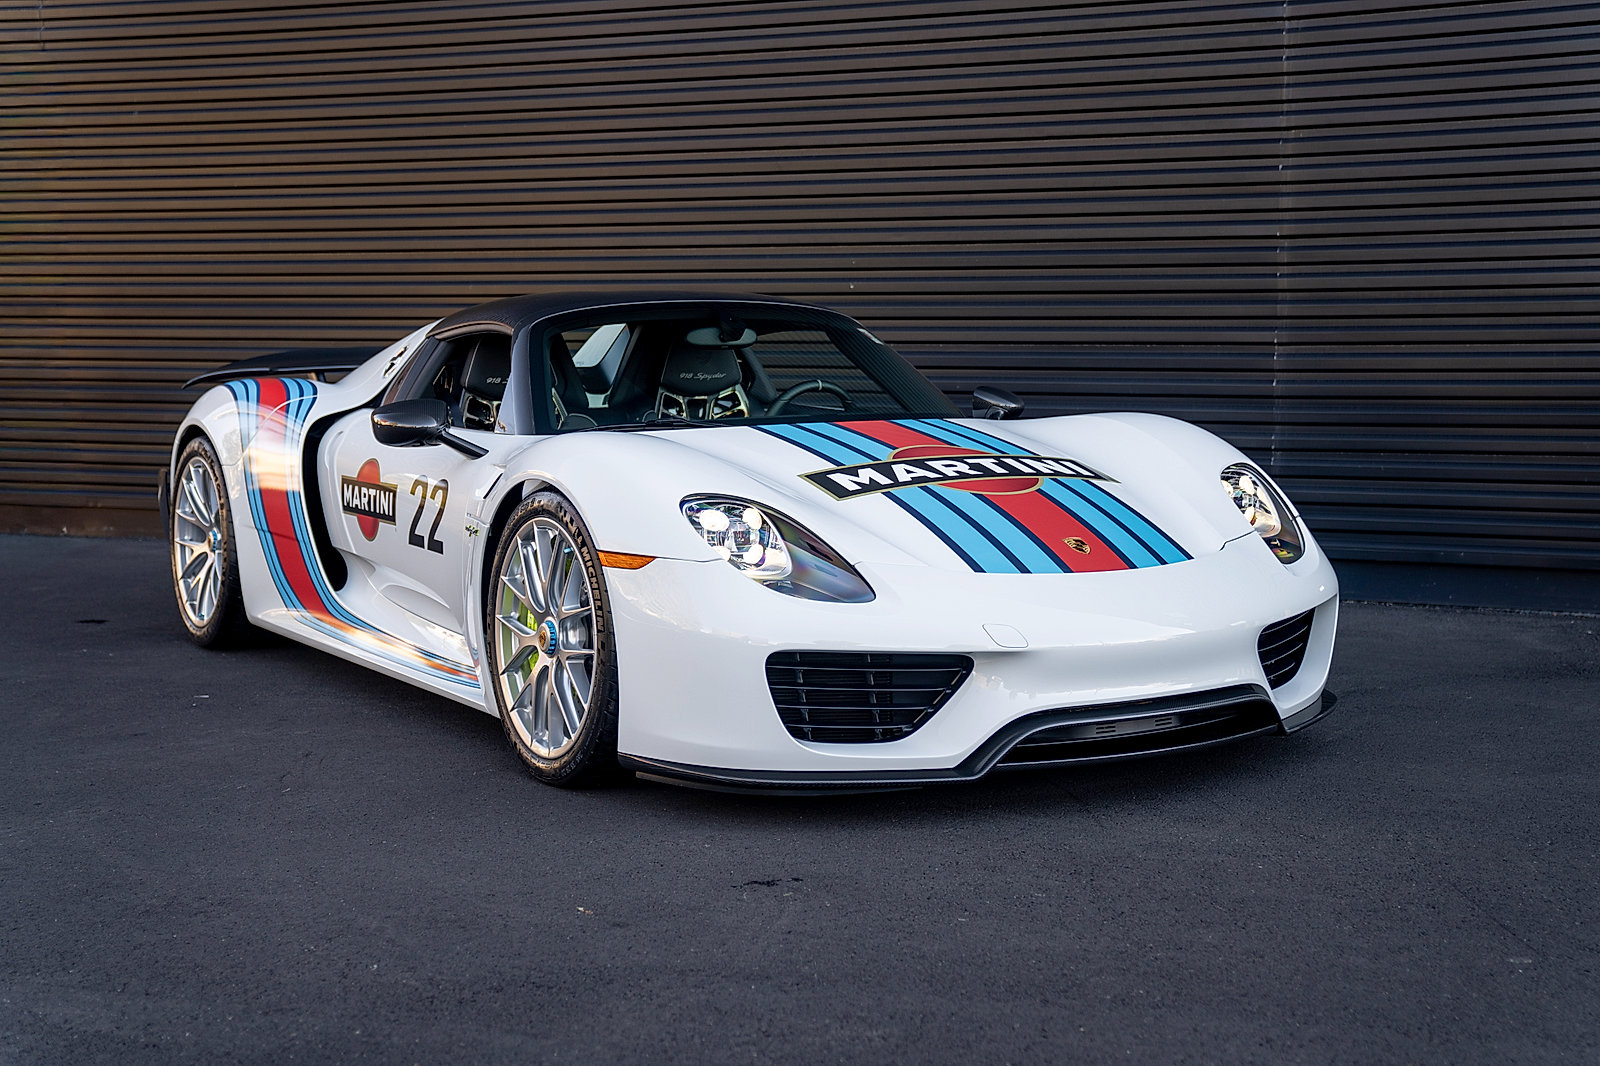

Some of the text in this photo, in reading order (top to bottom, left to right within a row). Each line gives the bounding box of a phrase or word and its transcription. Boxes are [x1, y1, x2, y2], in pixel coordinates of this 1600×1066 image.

[694, 372, 727, 381] Spyder
[826, 457, 1096, 492] MARTINI
[343, 483, 394, 517] MARTINI
[408, 474, 449, 555] 22
[580, 545, 606, 633] MICHELIN
